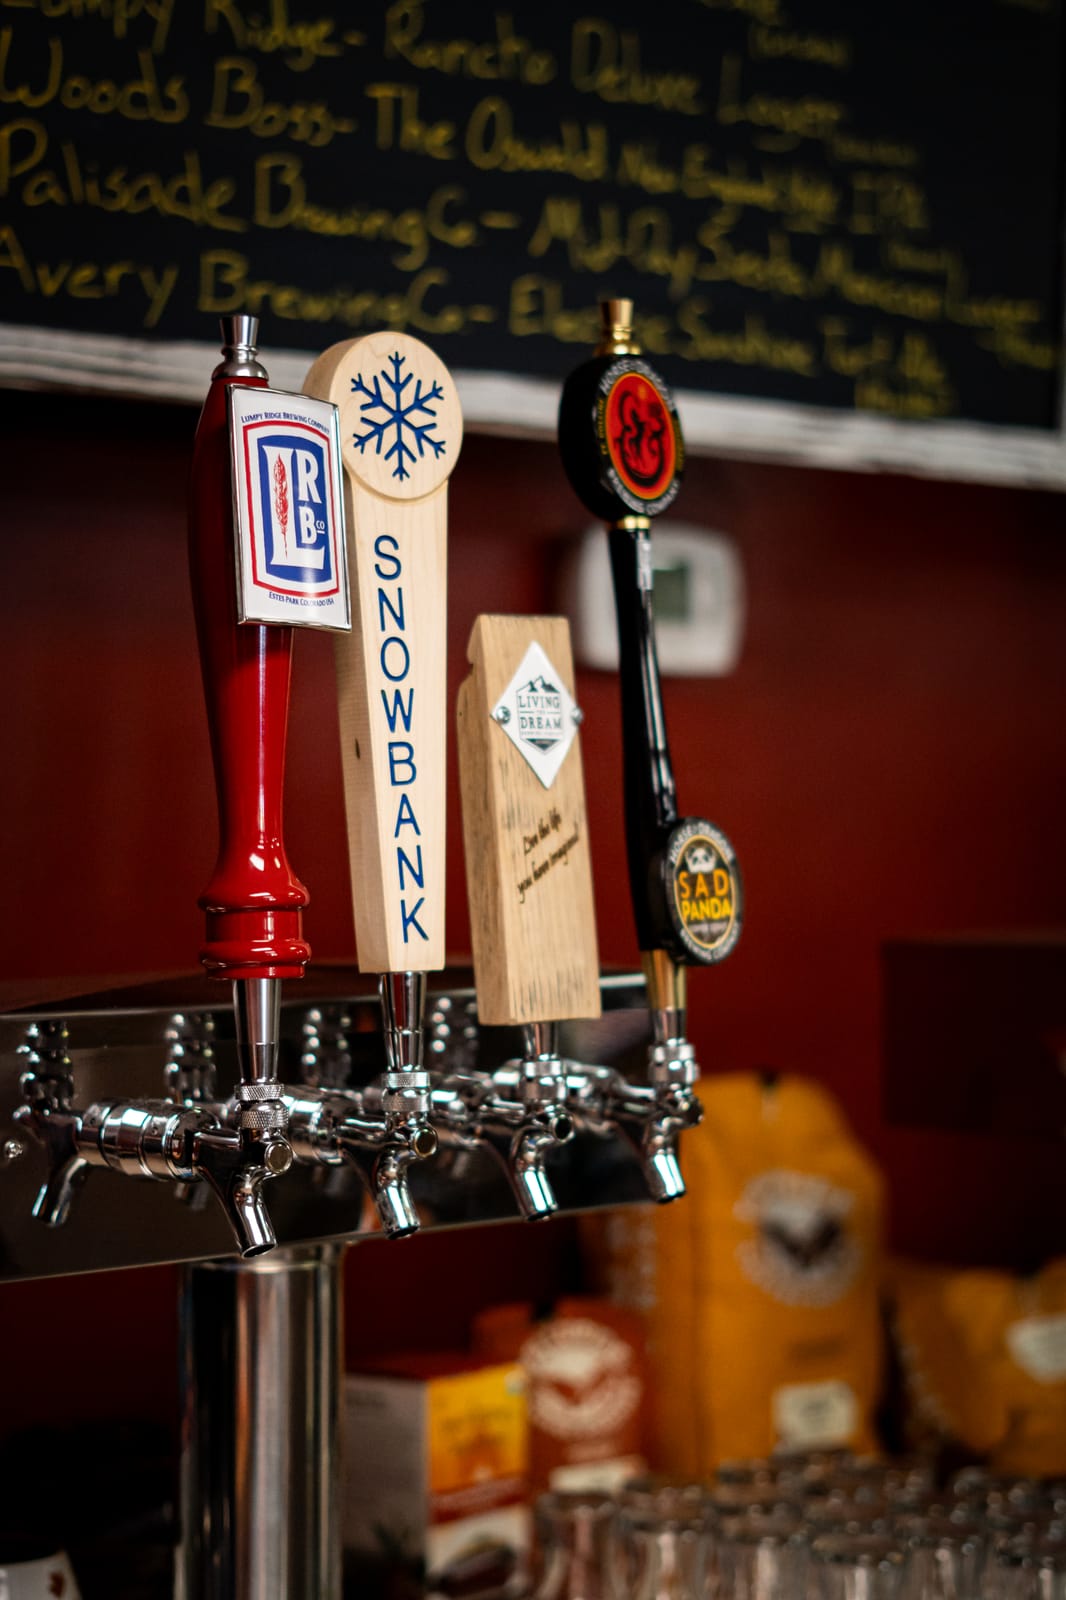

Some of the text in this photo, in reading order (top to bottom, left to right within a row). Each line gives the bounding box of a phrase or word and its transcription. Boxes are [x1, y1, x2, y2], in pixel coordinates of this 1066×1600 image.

[0, 25, 190, 124] Woods
[364, 80, 458, 160] The
[0, 116, 251, 234] Palisade
[0, 224, 179, 329] Avery
[241, 412, 263, 423] LUMPY
[283, 412, 308, 423] BREWING
[268, 591, 285, 602] ESTES
[285, 596, 299, 605] PARK
[518, 695, 560, 708] LIVING
[519, 716, 561, 729] DREAM
[374, 534, 429, 944] SNOWBANK
[678, 868, 729, 899] SAD
[681, 897, 731, 921] PANDA
